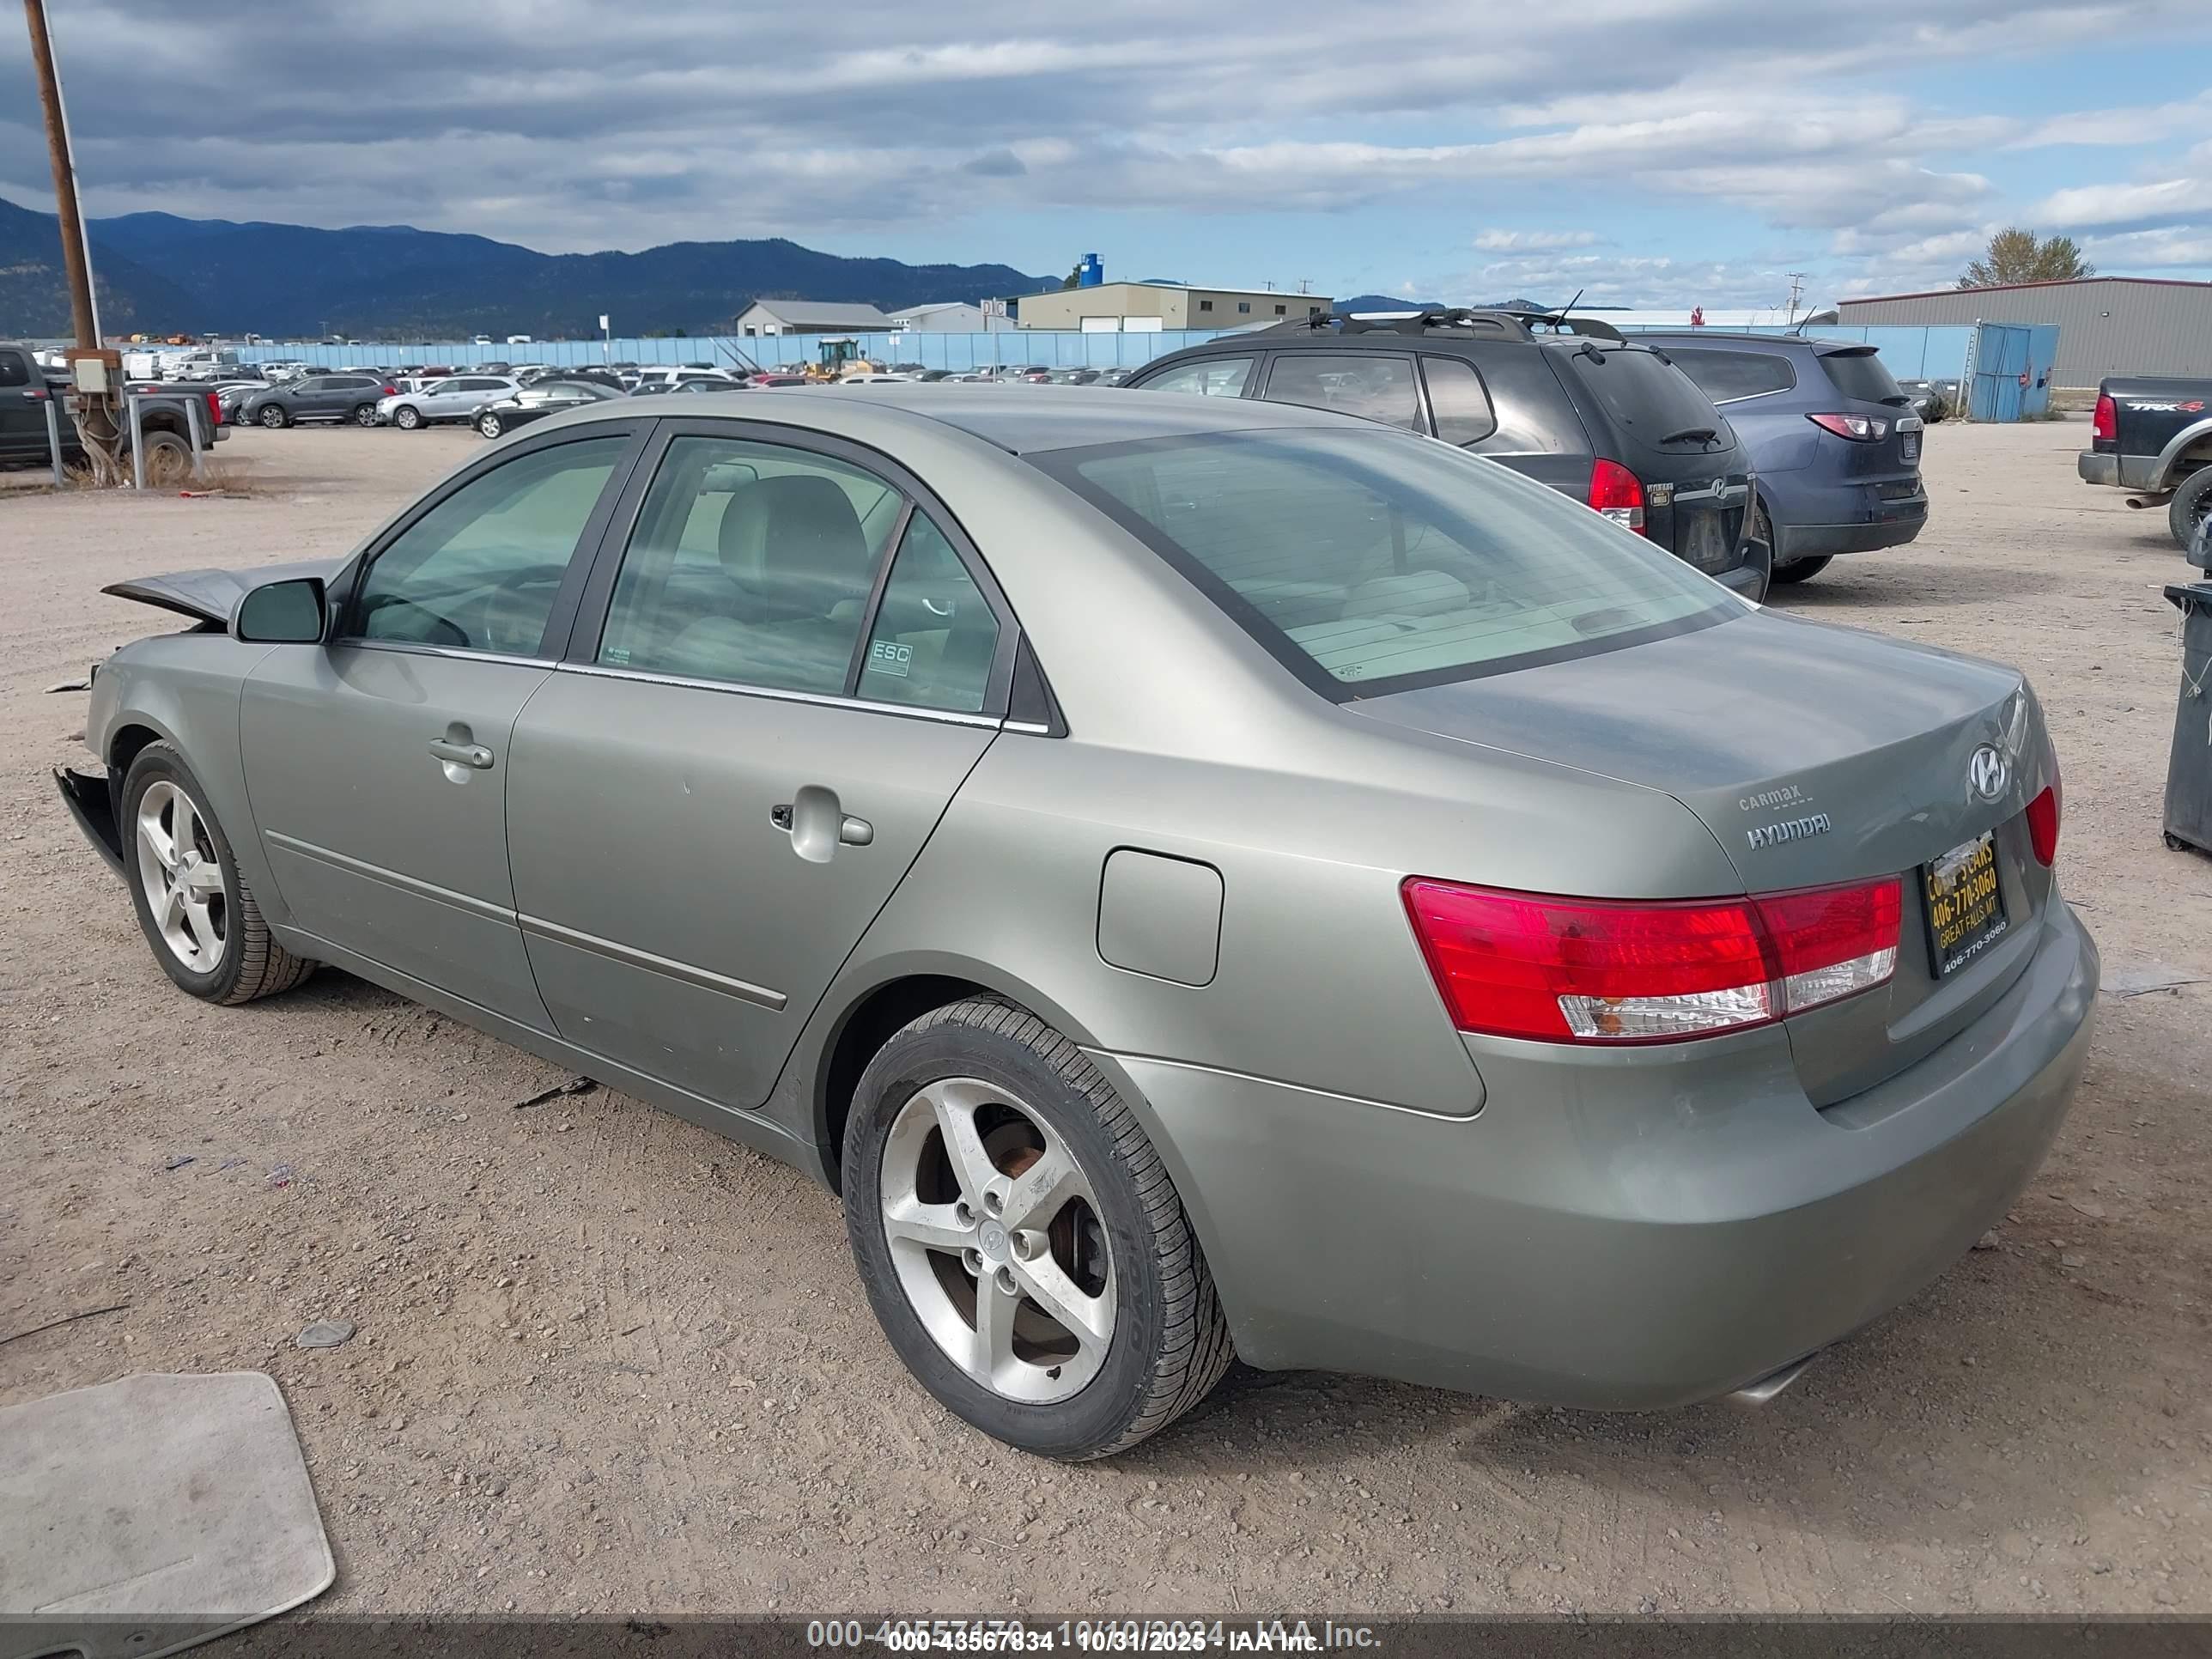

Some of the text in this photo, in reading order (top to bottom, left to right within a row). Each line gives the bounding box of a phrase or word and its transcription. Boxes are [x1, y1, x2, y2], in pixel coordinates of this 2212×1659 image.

[982, 301, 991, 314] D
[996, 302, 1005, 316] C
[872, 643, 910, 662] ESC
[1747, 813, 1831, 850] HYUNDAI
[1932, 867, 1997, 930] 406-770-3060
[1939, 920, 1965, 949] GREAT
[1985, 895, 1997, 915] MT
[1943, 921, 2007, 975] 406-770-3060
